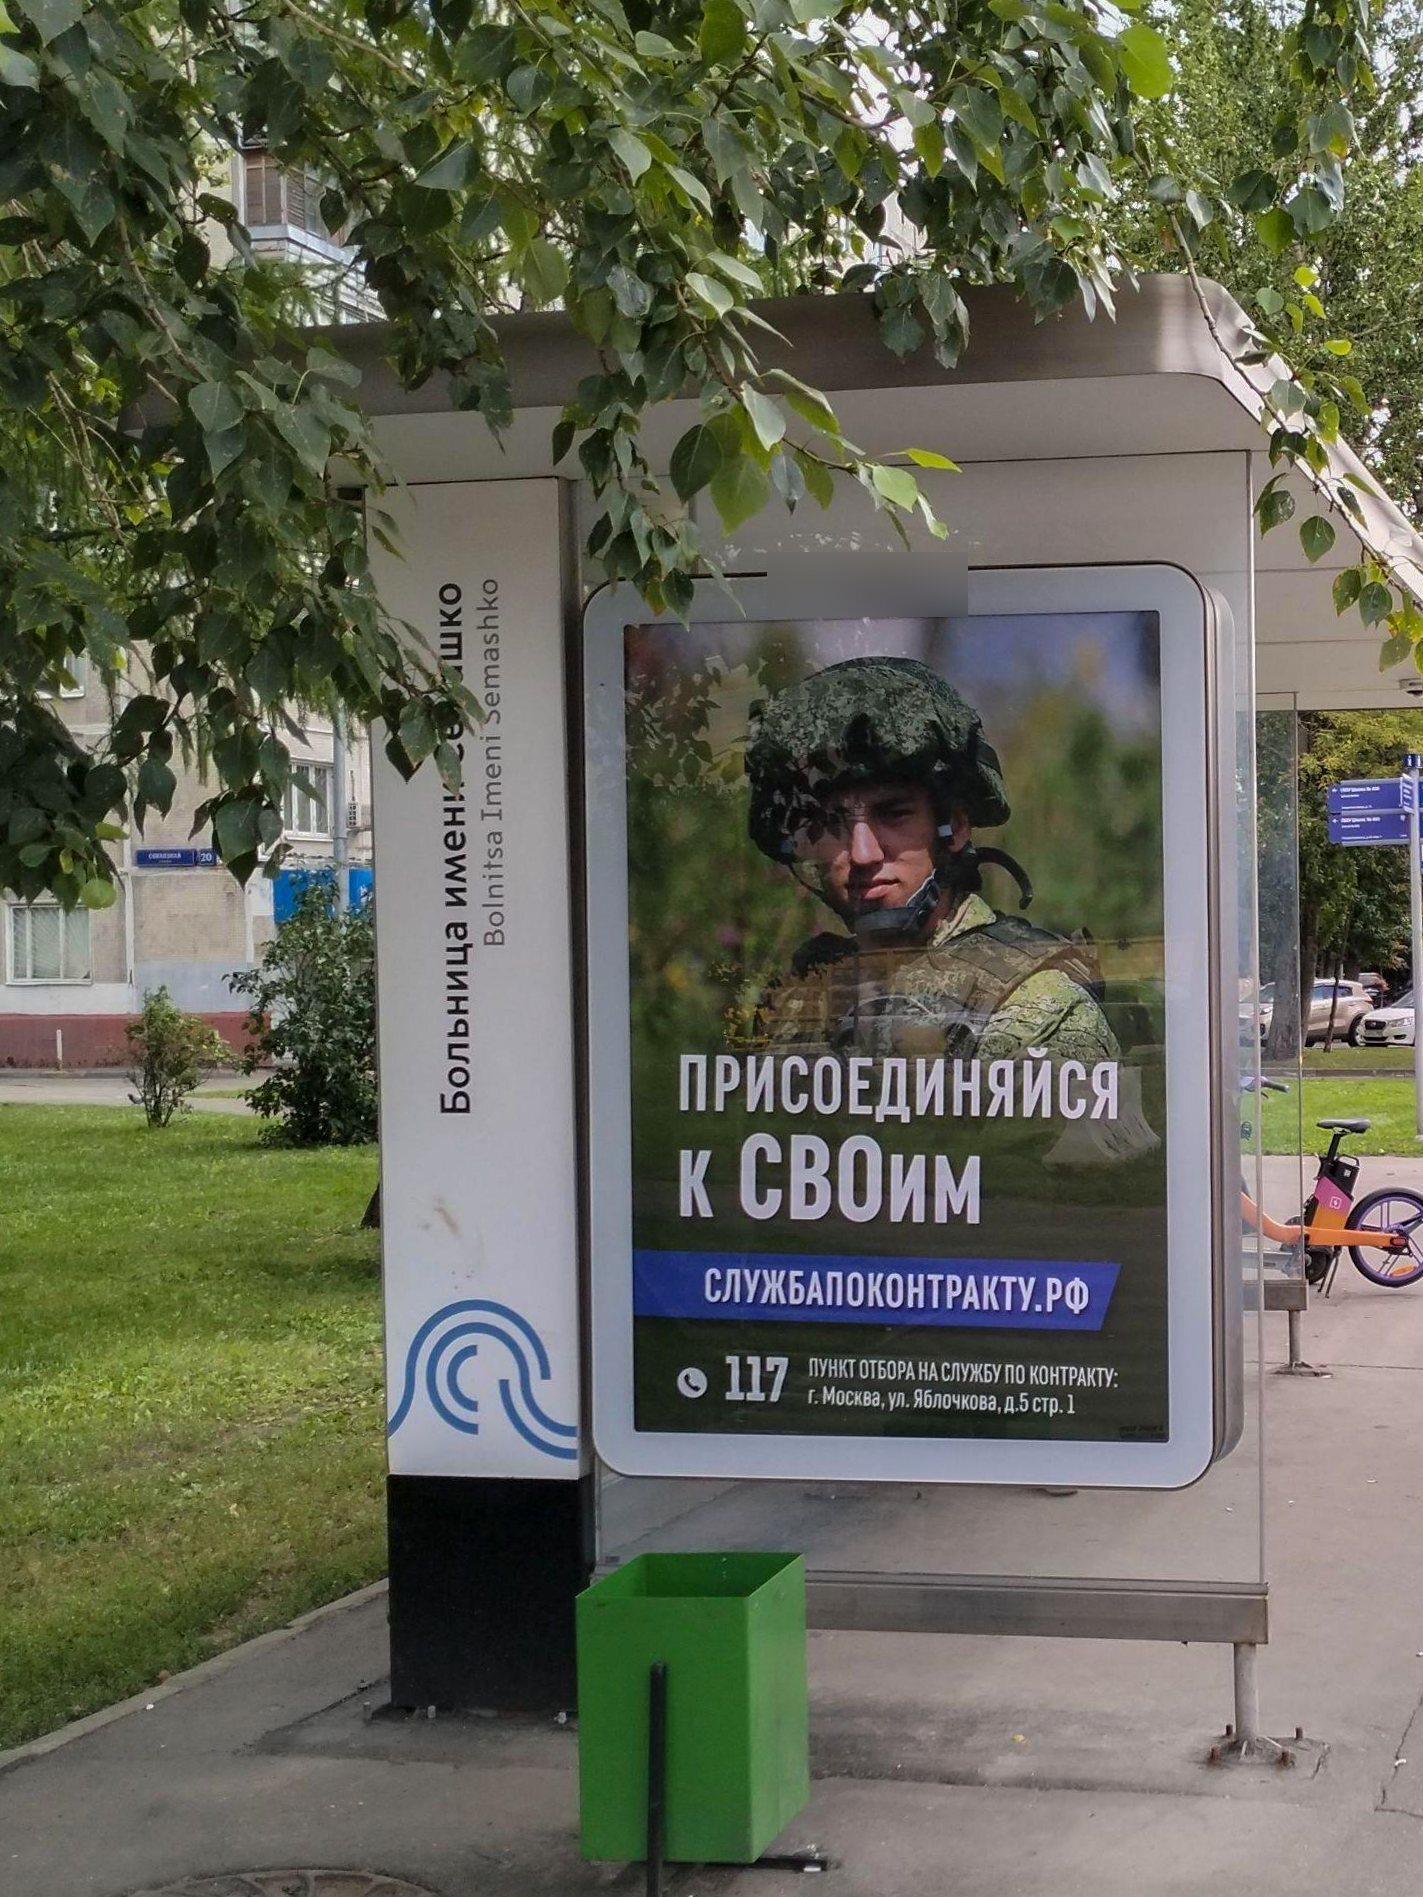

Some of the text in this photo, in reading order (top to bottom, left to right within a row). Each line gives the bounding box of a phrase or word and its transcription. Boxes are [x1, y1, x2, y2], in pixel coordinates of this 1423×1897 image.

[435, 582, 465, 764] ешко
[476, 578, 504, 946] Bolnitsa Imeni Semashko
[201, 853, 212, 862] 20
[440, 922, 473, 1113] Больница
[679, 1047, 1118, 1123] ПРИСОЕДИНЯЙСЯ
[704, 1267, 1089, 1314] СЛУЖБАПОКОНТРАКТУ.РФ
[725, 1355, 789, 1402] 117
[808, 1357, 1119, 1388] ПУНКТ ОТБОРА НА СЛУЖБУ ПО КОНТРАКТУ:
[808, 1386, 1075, 1417] г. Москва, ул. Яблочкова, д.5 стр. 1
